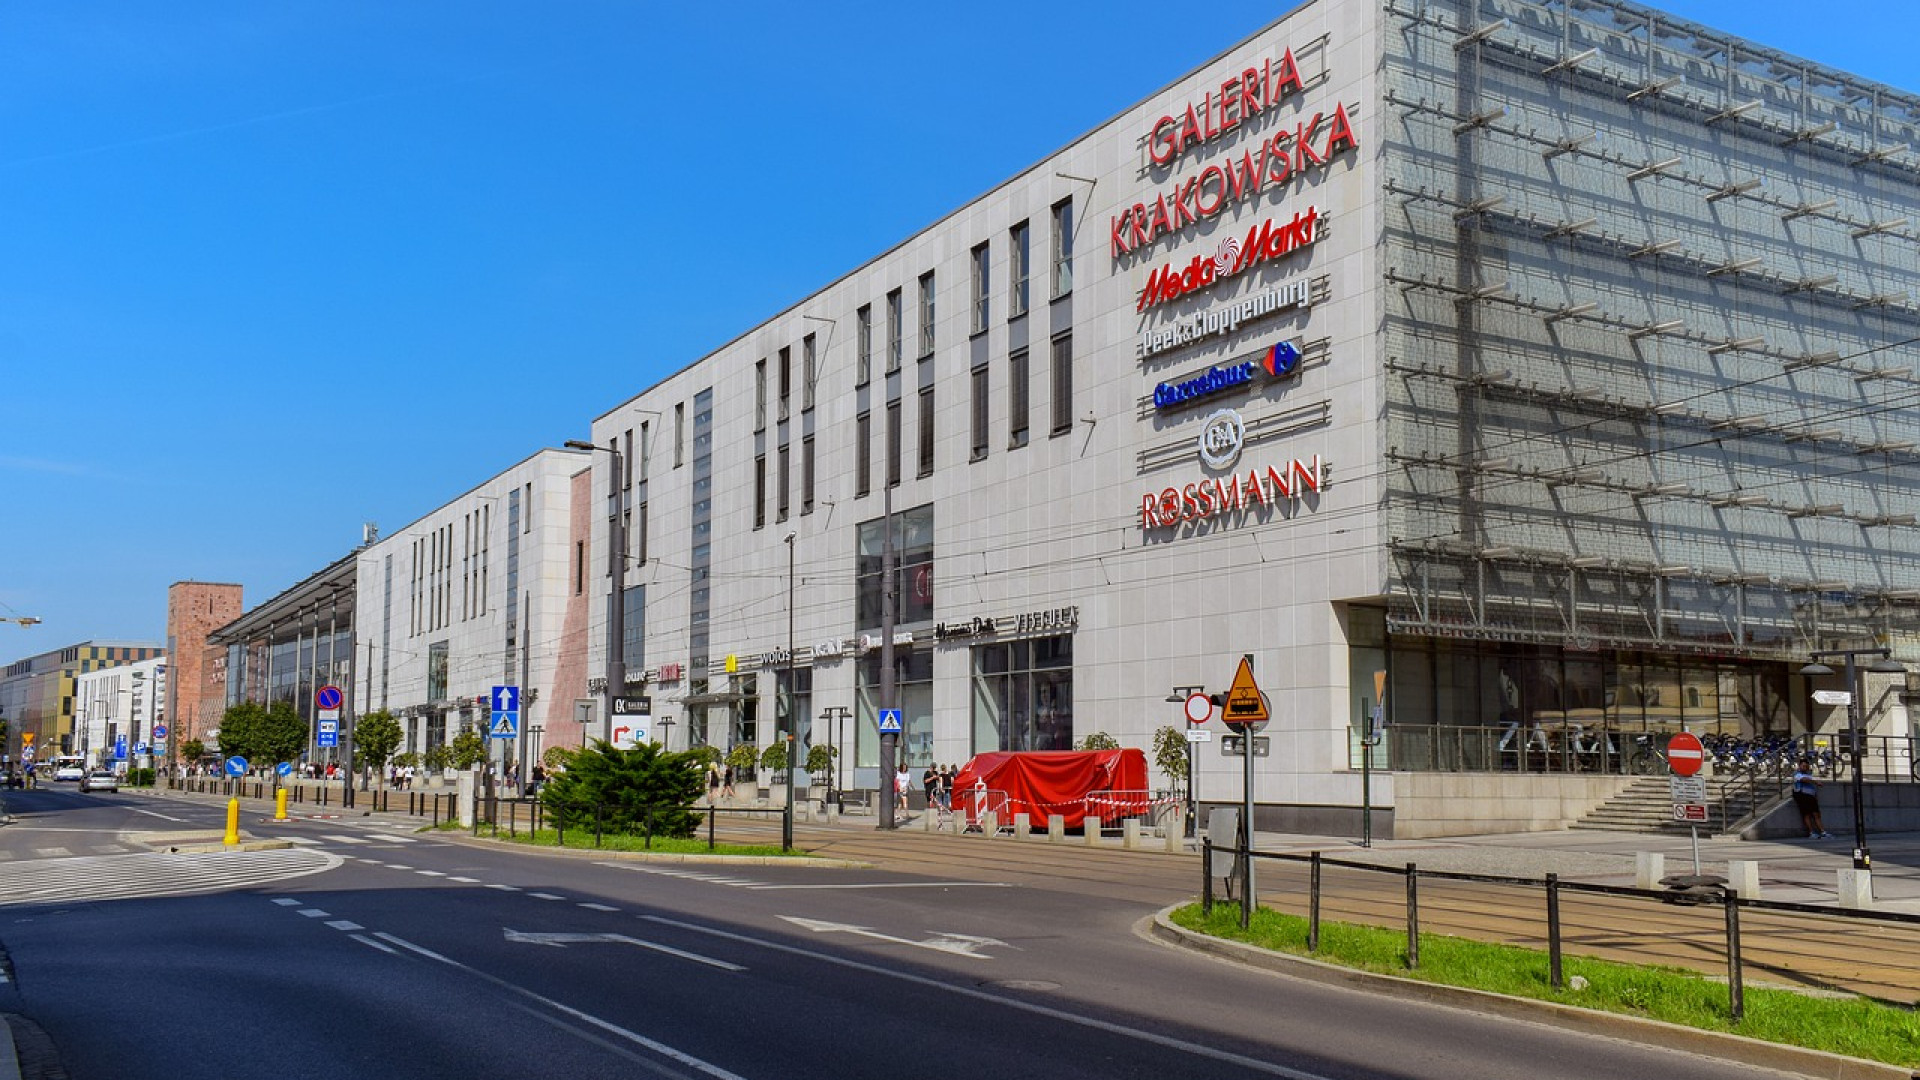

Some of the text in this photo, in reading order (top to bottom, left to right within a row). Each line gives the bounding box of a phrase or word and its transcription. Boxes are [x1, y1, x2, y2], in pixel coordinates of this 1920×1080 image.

[1149, 45, 1302, 164] GALERIA
[1110, 100, 1357, 259] KRAKOWSKA
[1136, 205, 1318, 312] Media Markt
[1154, 361, 1255, 409] Carrefour
[1207, 422, 1237, 452] C&A
[1142, 454, 1321, 529] ROSSMANN
